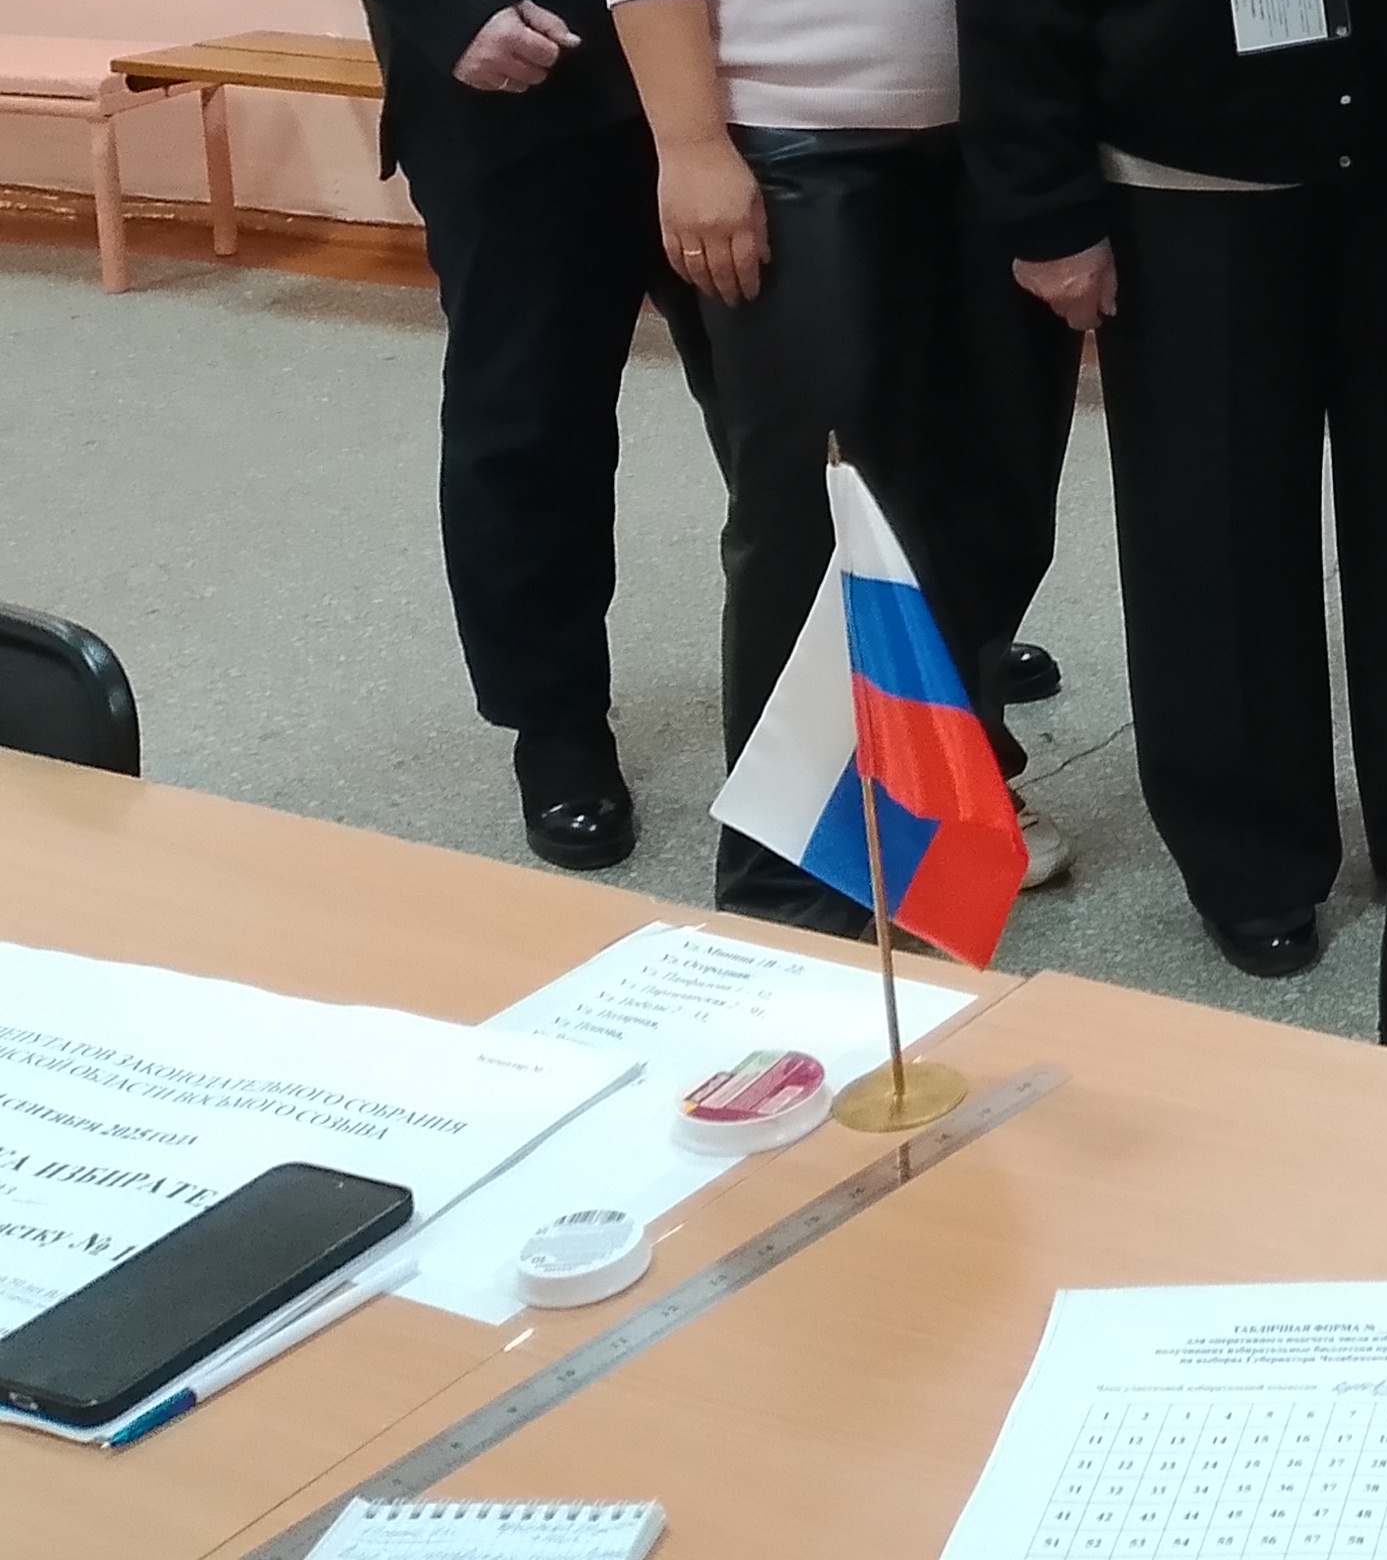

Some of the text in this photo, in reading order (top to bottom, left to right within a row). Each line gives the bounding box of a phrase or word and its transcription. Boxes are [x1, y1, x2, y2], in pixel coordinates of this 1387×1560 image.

[70, 1065, 177, 1100] ОБЛАСТИ
[172, 1091, 297, 1117] ВОСЬМОГО
[295, 1109, 389, 1140] СОЗЫВА
[114, 1054, 343, 1106] ЗАКОНОДАТЕЛЬНОГО
[344, 1098, 468, 1135] СОБРАНИЯ
[2, 1097, 199, 1146] СЕНТЯБРЯ 2025 ГОДА
[34, 1161, 220, 1208] ИЗБИРАТЕ
[68, 1233, 112, 1256] №
[1314, 1324, 1360, 1333] ФОРМА
